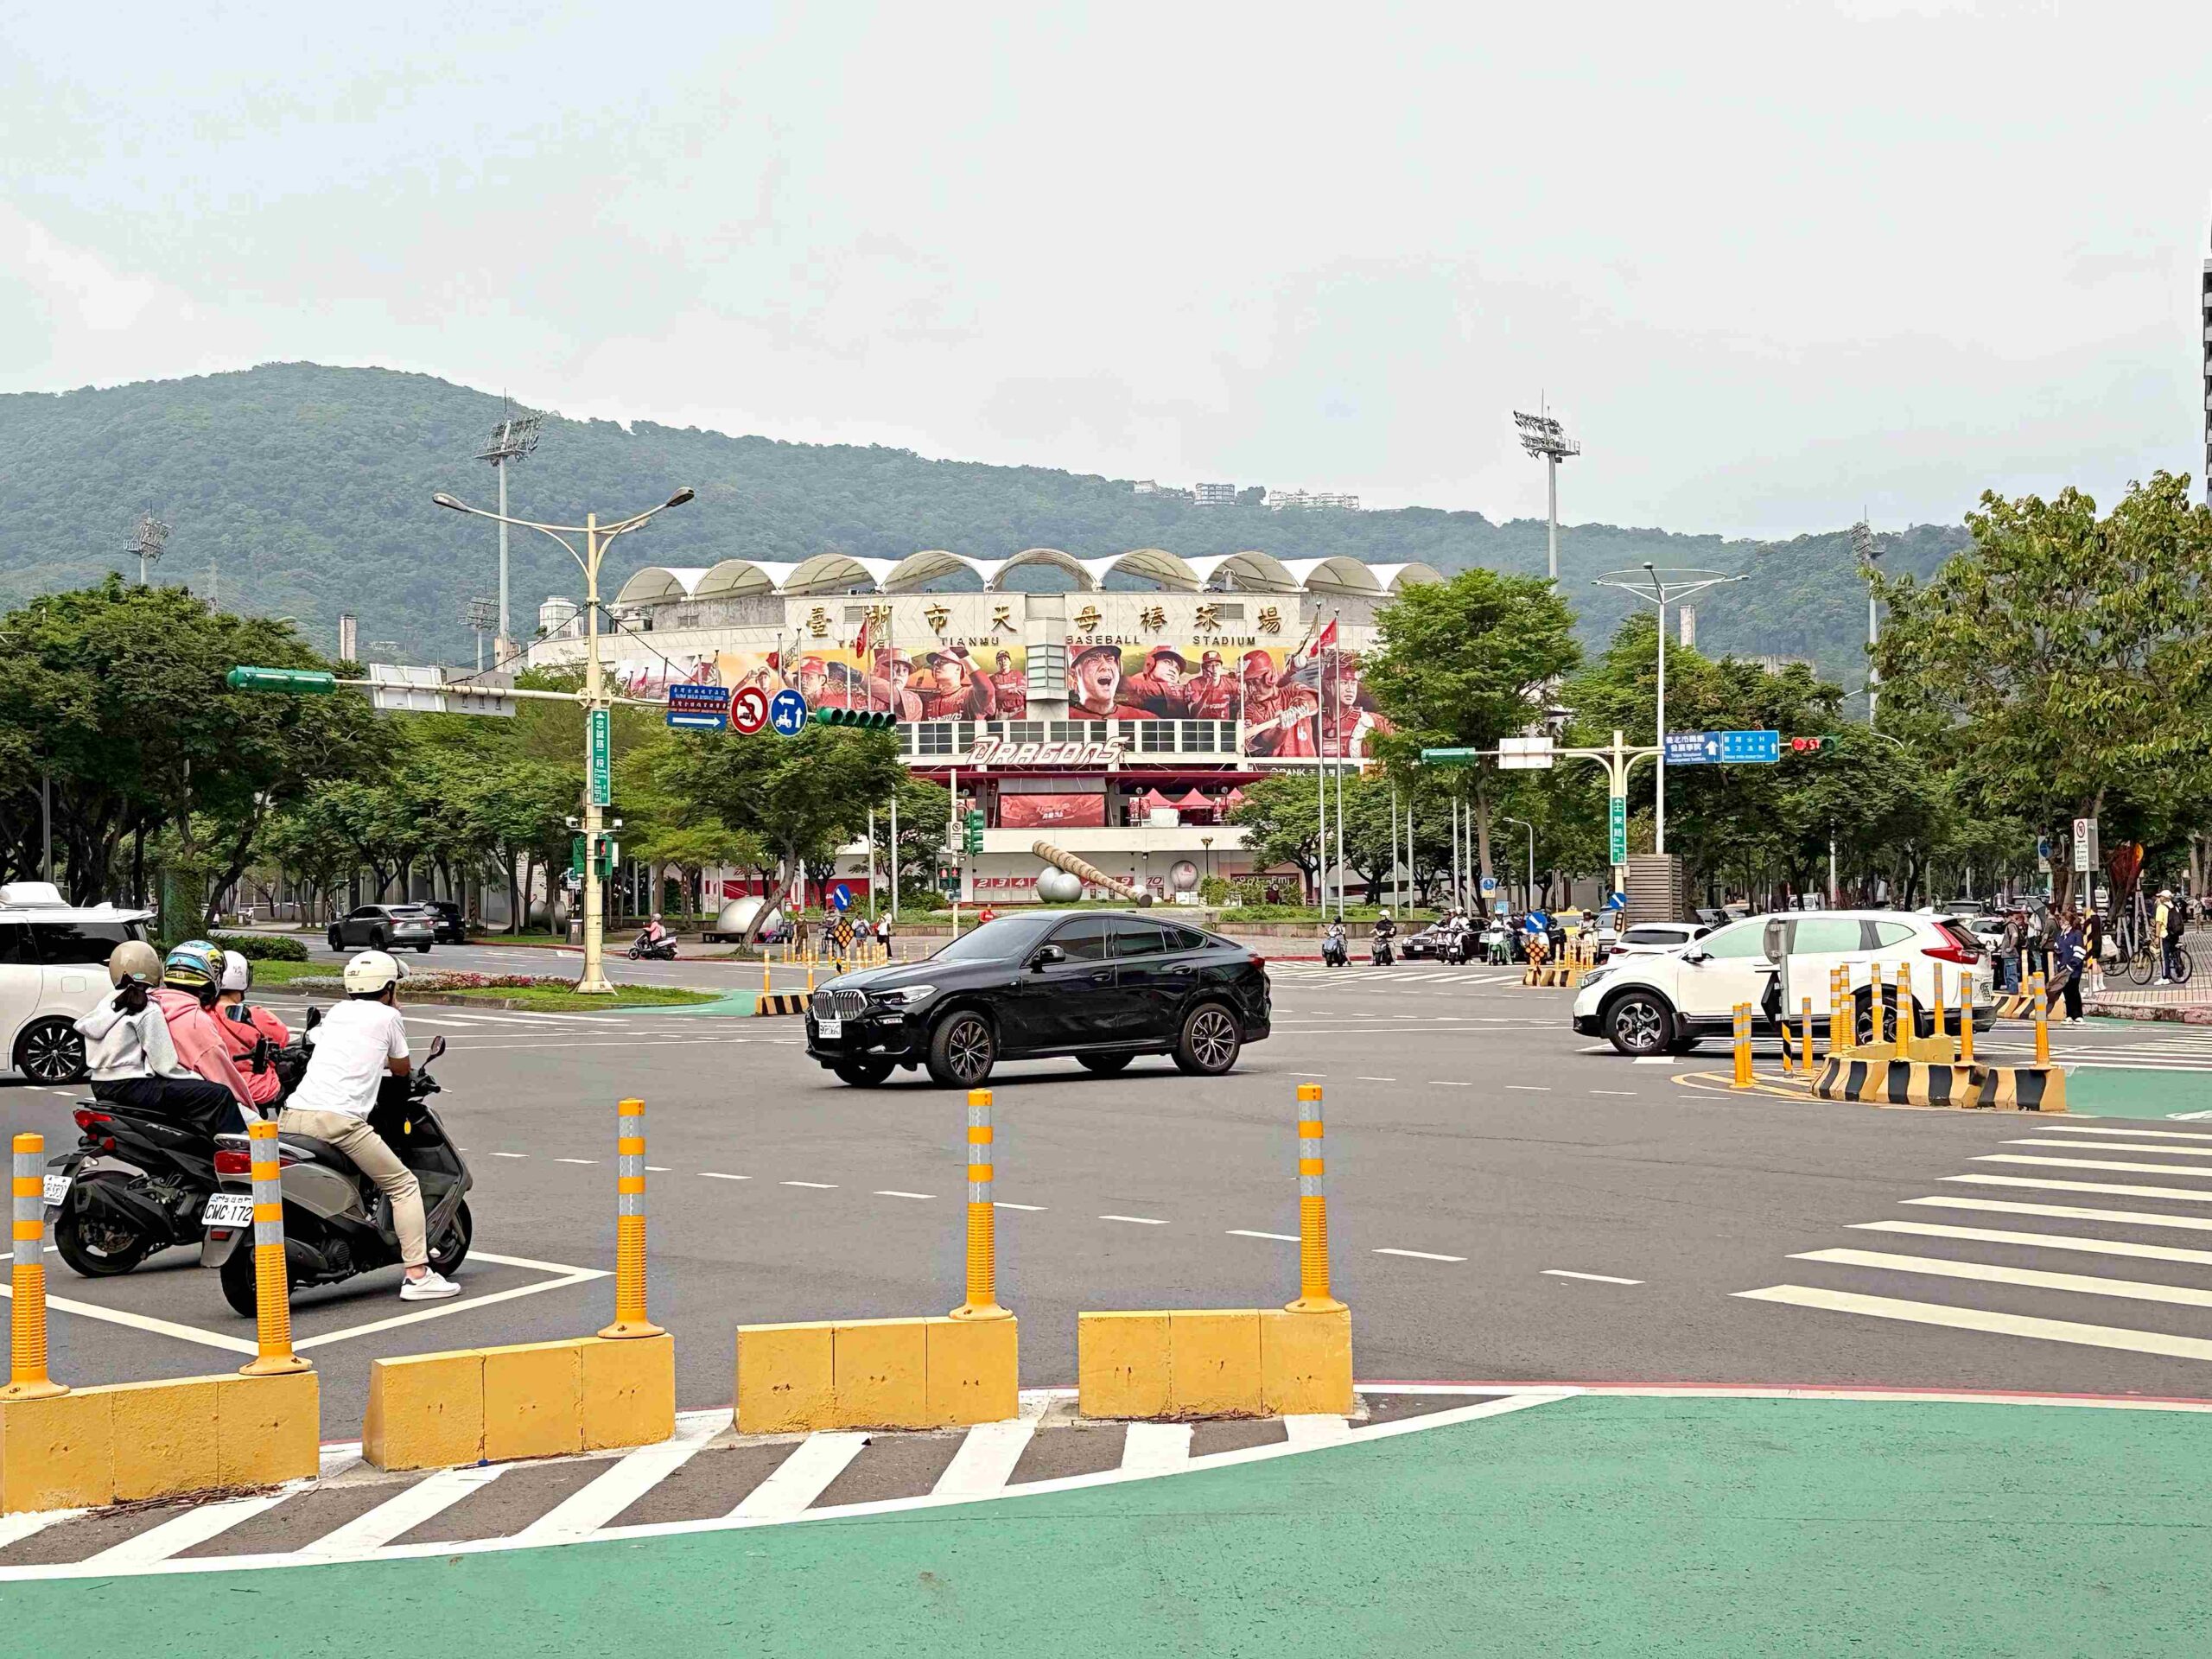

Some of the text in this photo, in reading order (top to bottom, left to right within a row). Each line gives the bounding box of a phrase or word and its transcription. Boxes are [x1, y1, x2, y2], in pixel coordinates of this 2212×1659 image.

[941, 637, 1000, 647] TIANMU
[1065, 635, 1141, 645] BASEBALL
[1193, 636, 1256, 646] STADIUM
[966, 735, 1130, 765] DRAGONS
[976, 879, 988, 887] 2
[1147, 876, 1162, 885] 10
